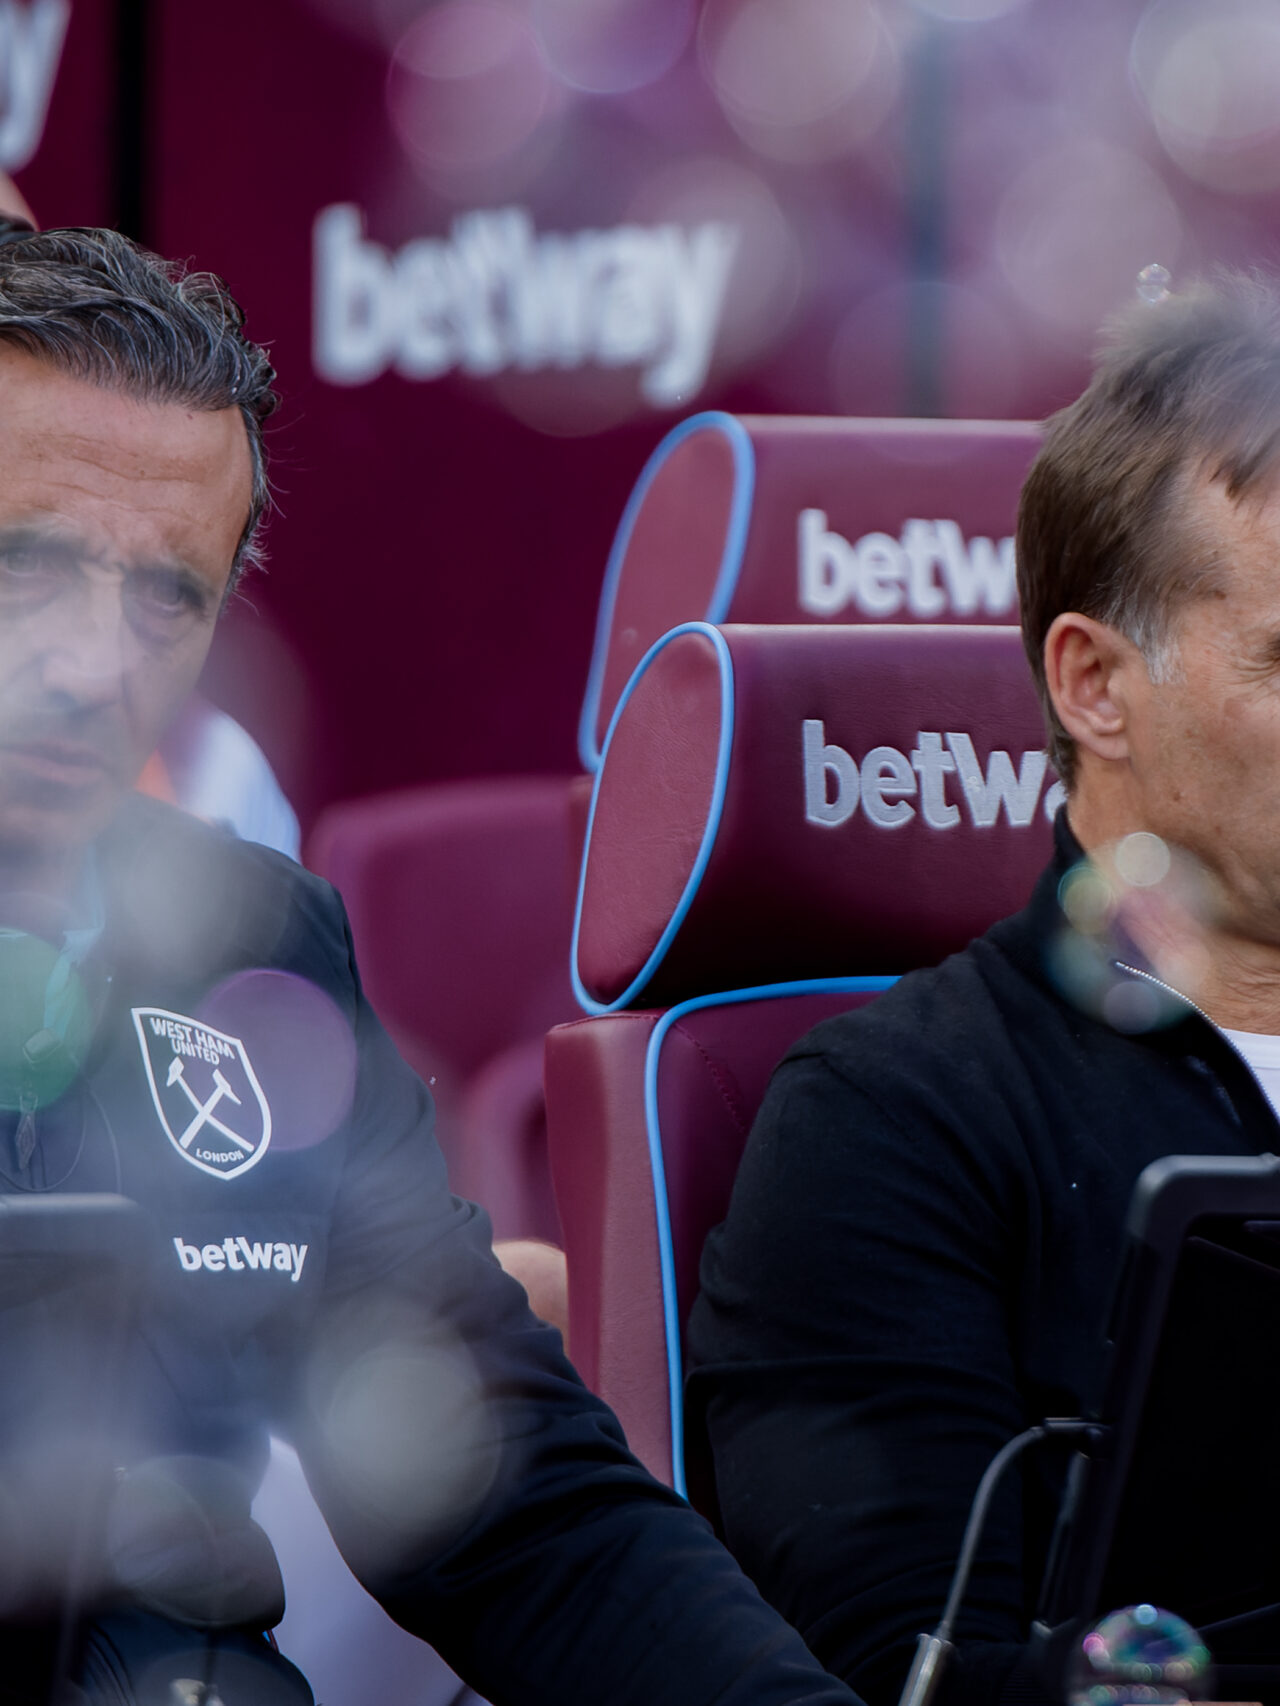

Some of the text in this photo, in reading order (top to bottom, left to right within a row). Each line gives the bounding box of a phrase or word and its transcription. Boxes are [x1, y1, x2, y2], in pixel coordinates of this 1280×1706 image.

[313, 203, 738, 407] betway
[150, 1017, 235, 1060] WEST HAM
[171, 1037, 220, 1066] UNITED
[196, 1148, 244, 1163] LONDON
[173, 1236, 308, 1282] betway
